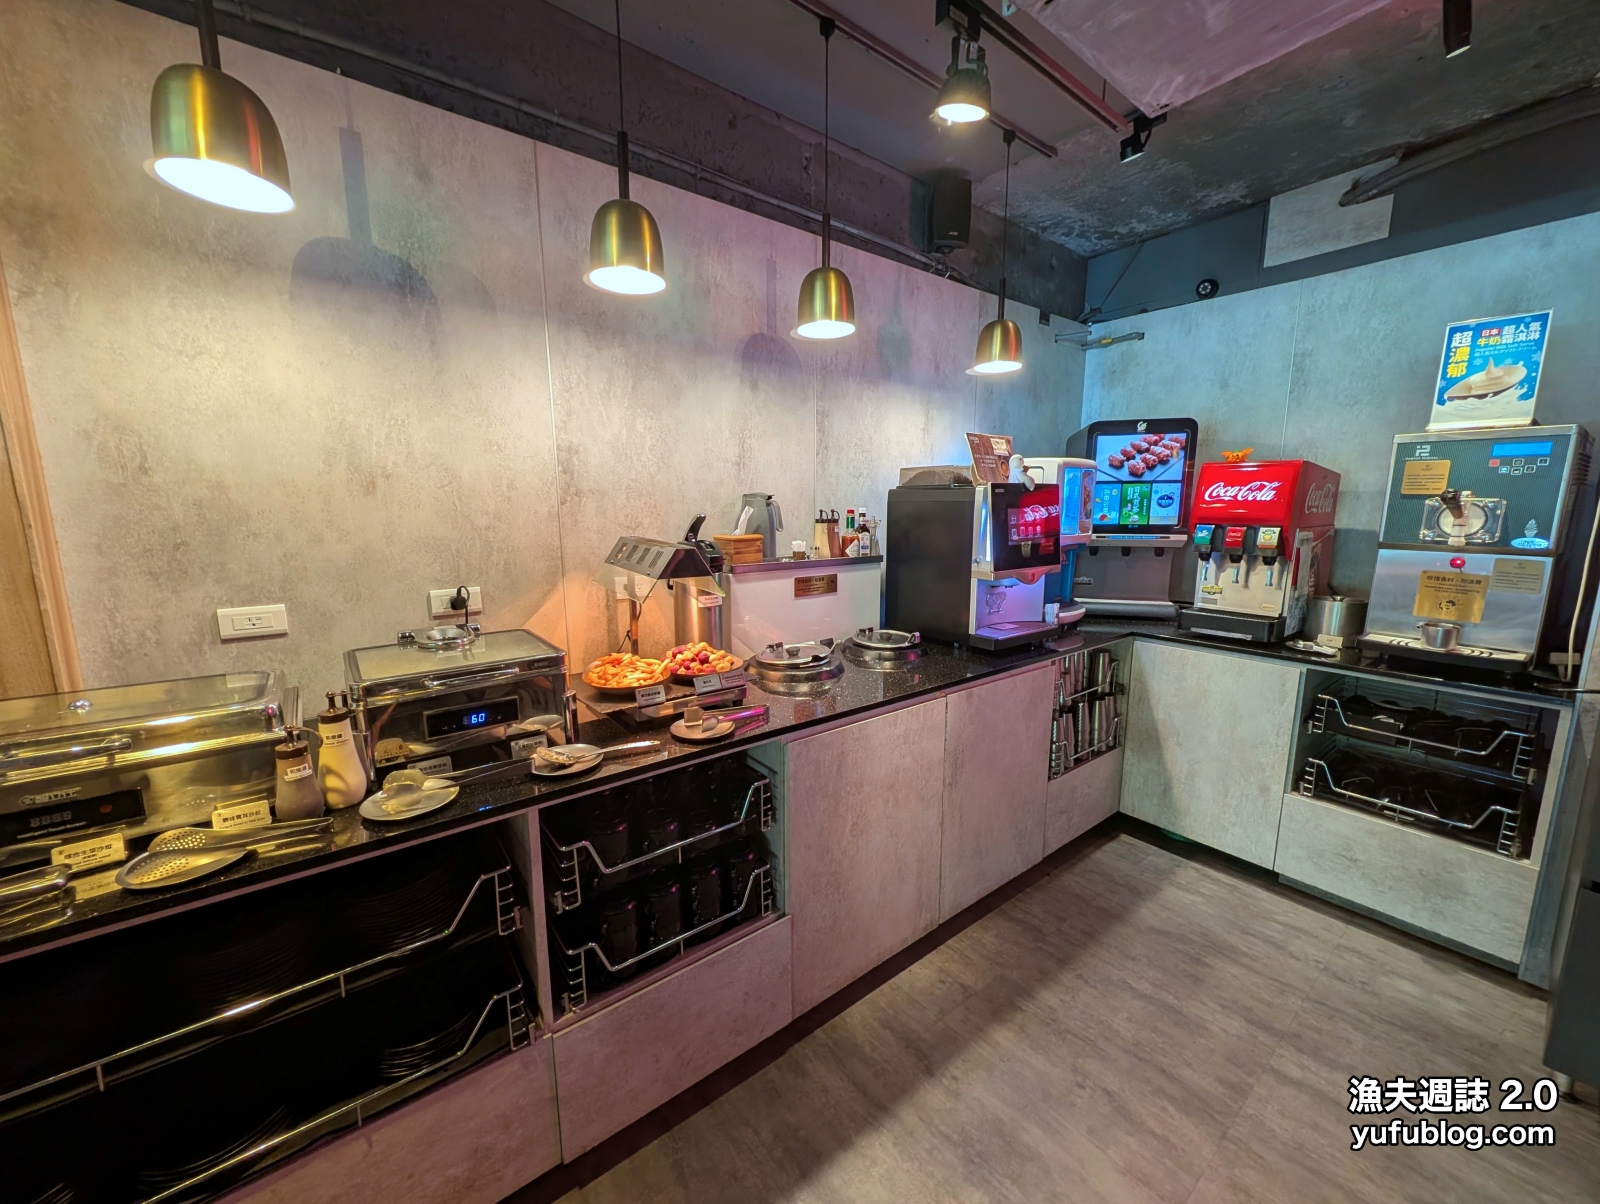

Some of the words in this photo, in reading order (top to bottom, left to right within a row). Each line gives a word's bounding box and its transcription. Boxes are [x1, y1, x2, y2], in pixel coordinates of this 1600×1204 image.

[1482, 328, 1500, 337] 日本
[1502, 322, 1542, 336] 超人氣
[1446, 331, 1473, 378] 超濃郁
[1204, 481, 1283, 501] Coca-Cola
[1305, 482, 1336, 514] Coca-Cola
[471, 713, 486, 724] 60
